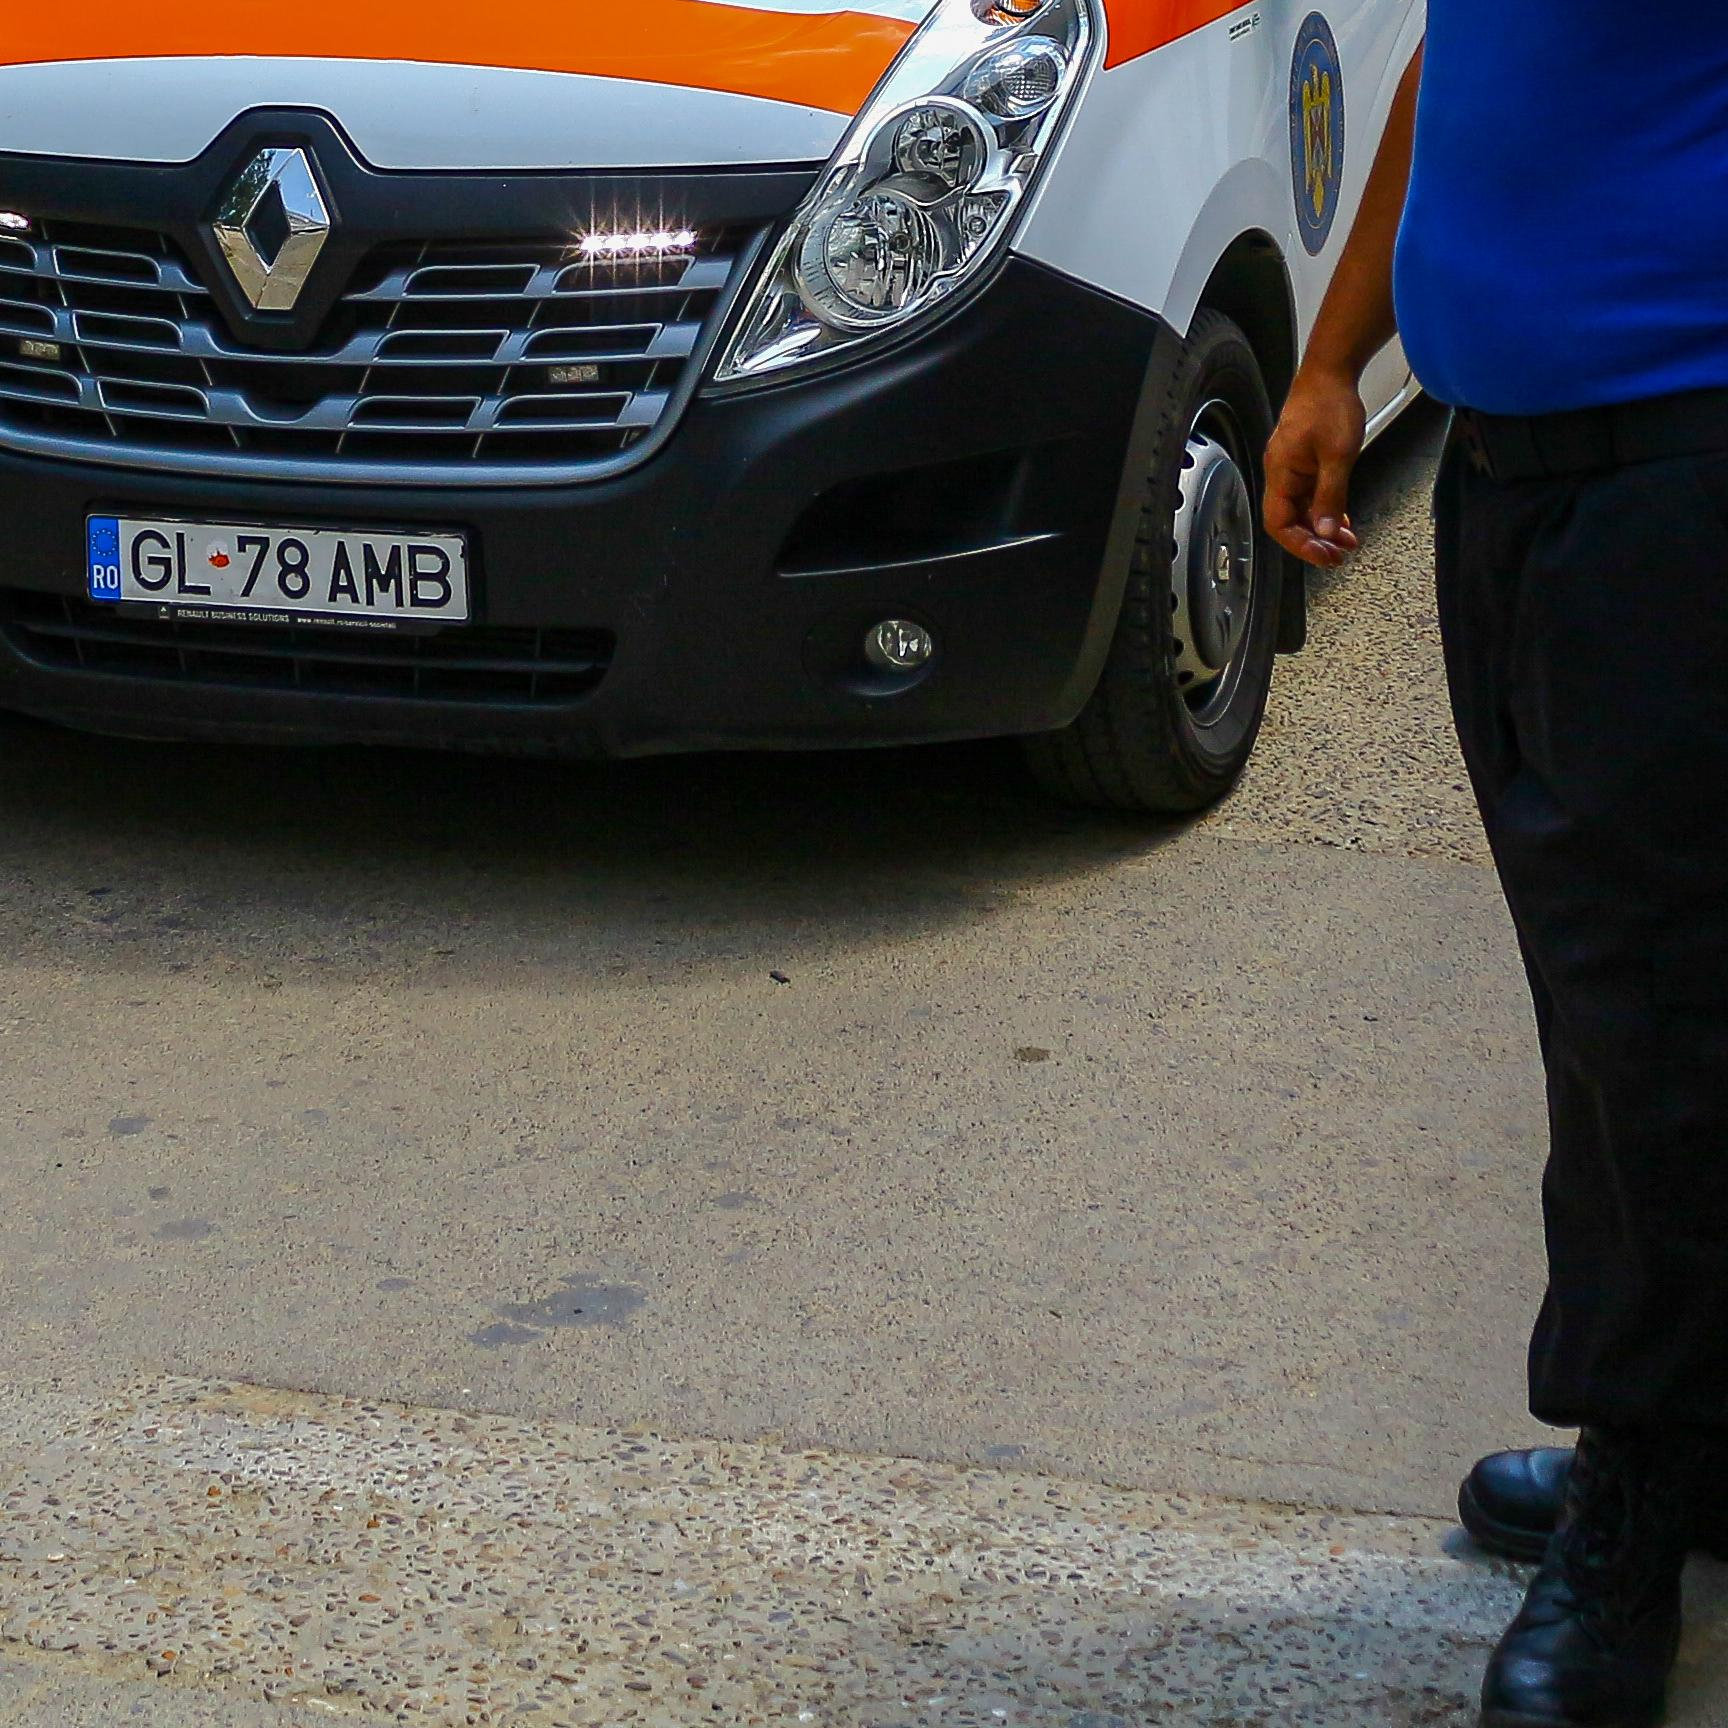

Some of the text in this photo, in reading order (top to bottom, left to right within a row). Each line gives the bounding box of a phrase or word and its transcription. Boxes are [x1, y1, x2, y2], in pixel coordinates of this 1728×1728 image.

[93, 564, 118, 590] RO
[131, 529, 453, 609] GL 78 AMB
[177, 609, 209, 619] RENAULT
[248, 613, 290, 623] SOLUTIONS
